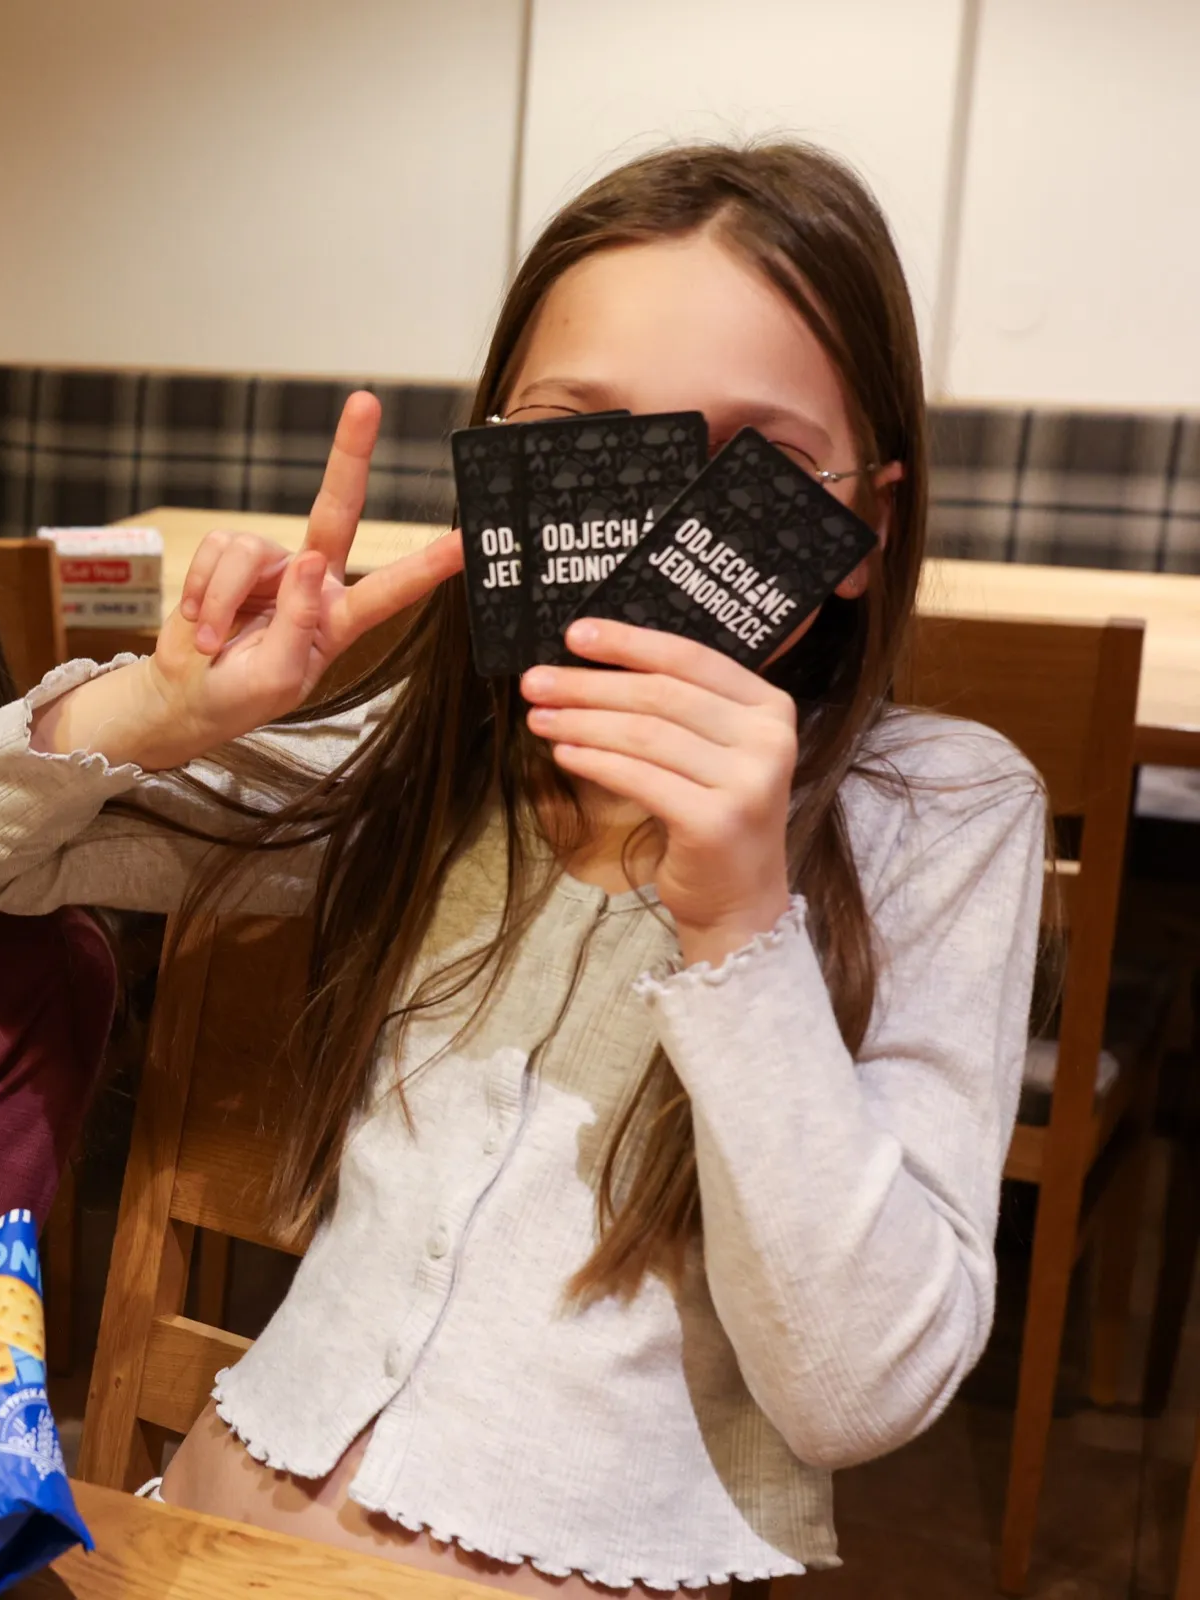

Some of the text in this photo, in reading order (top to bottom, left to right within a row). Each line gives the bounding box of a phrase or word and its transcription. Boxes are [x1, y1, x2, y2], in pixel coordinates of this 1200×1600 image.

[541, 553, 627, 585] JEDNO
[648, 545, 772, 649] JEDNOROŻCE
[674, 518, 798, 625] ODJECHANE
